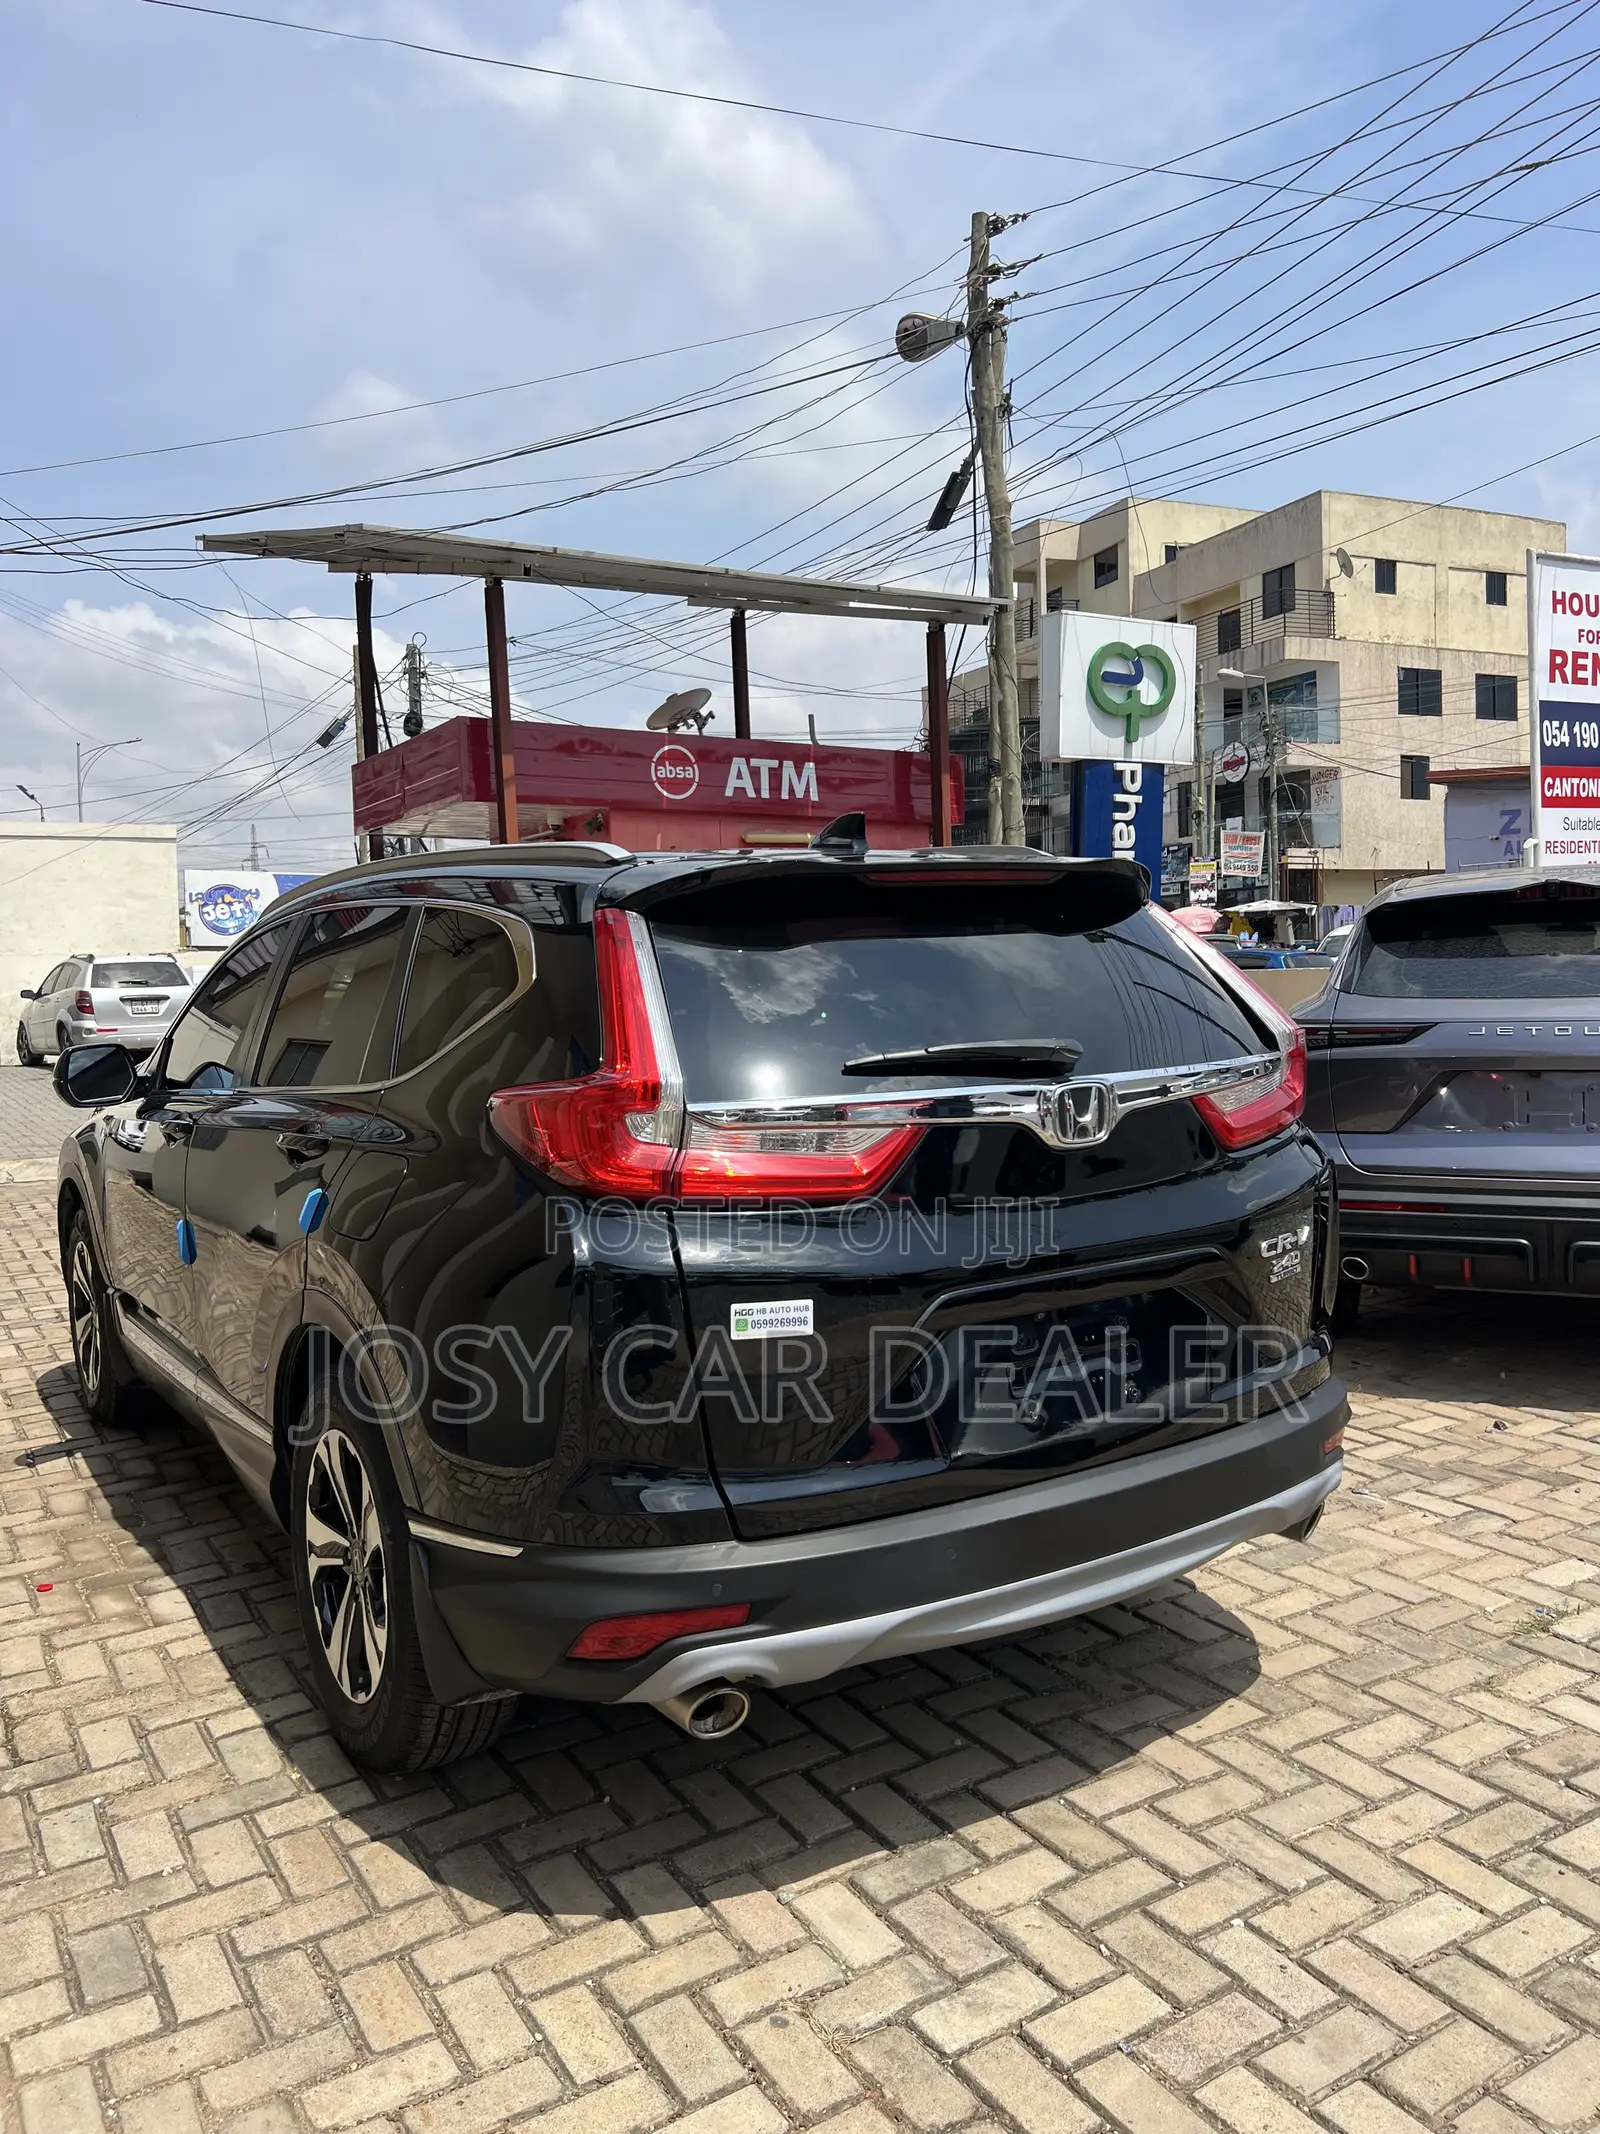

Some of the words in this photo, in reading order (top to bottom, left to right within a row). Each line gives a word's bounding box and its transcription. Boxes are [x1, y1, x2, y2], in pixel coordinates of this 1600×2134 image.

[1551, 590, 1600, 618] HOU
[1543, 719, 1570, 748] 054
[1573, 721, 1599, 749] 190
[656, 760, 694, 779] absa
[724, 756, 820, 802] ATM
[1543, 776, 1600, 798] CANTON
[1468, 1026, 1600, 1036] JETOU
[1260, 1225, 1311, 1258] CR-V
[1270, 1249, 1301, 1275] 240
[750, 1316, 809, 1330] 0599269996
[756, 1307, 768, 1316] HB
[769, 1305, 792, 1315] AUTO
[793, 1304, 810, 1313] HUB
